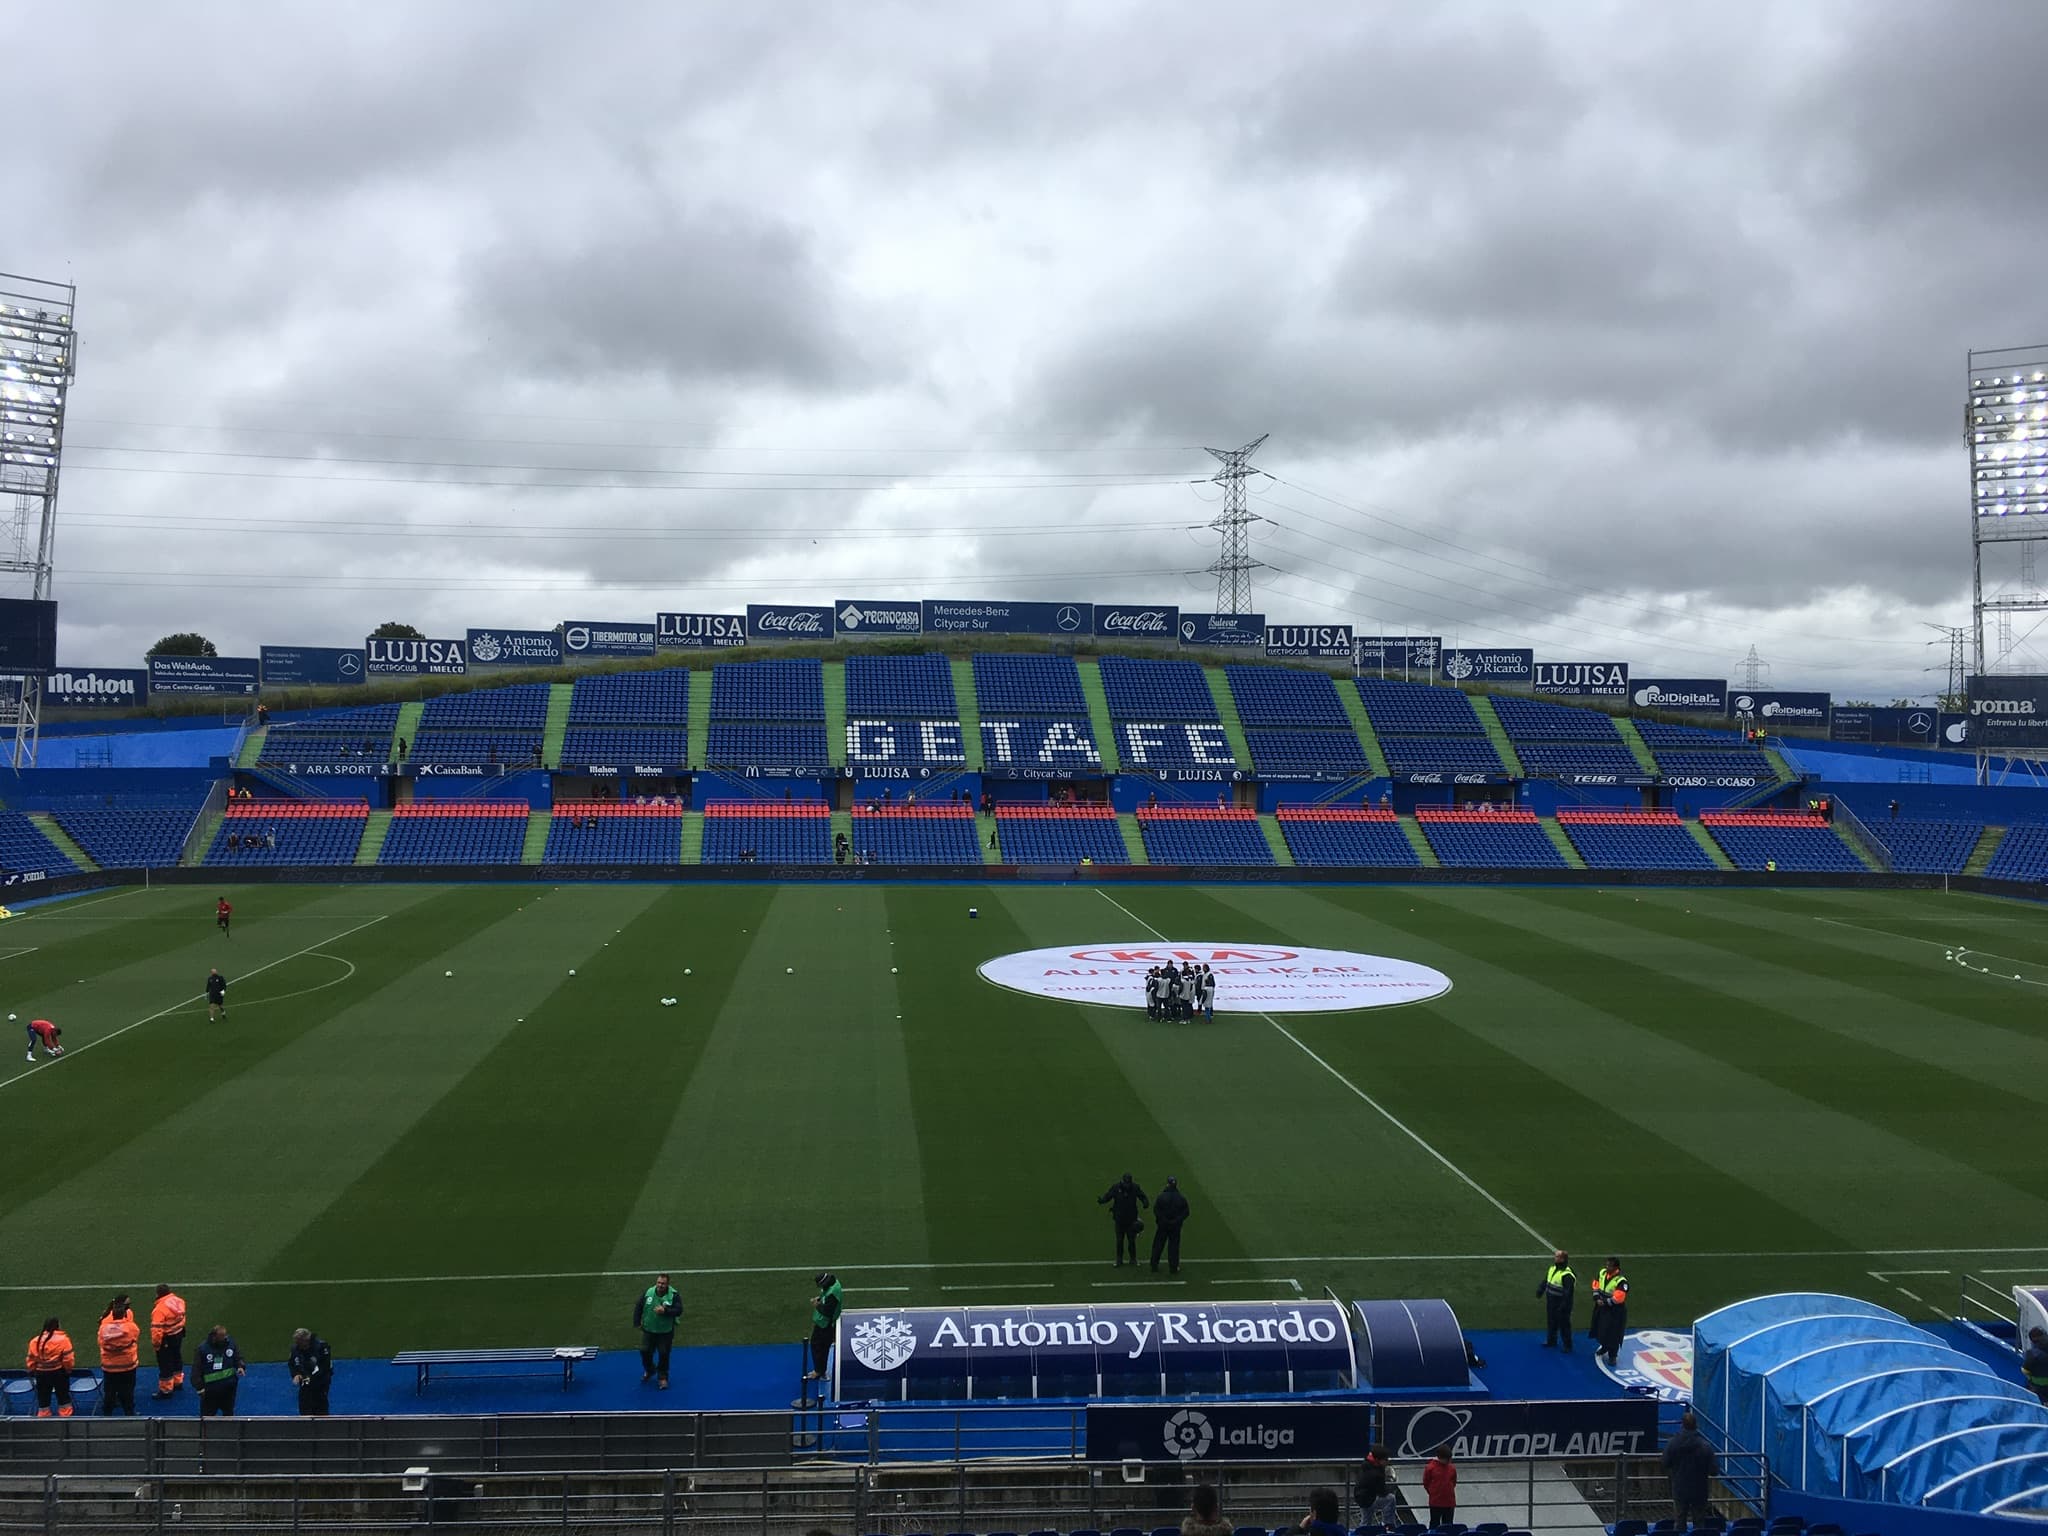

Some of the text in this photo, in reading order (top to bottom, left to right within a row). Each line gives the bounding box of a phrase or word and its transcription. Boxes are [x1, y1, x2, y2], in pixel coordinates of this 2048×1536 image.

[863, 610, 920, 625] TECNOCASA
[933, 606, 1010, 617] Mercedes-Benz
[659, 615, 744, 637] LUJISA
[758, 611, 823, 632] Coca-Cola
[933, 618, 990, 630] Citycar Sur
[1104, 611, 1168, 631] Coca-Cola
[503, 635, 552, 647] Antonio
[592, 631, 654, 643] TIBERMOTOR SUR
[1267, 628, 1350, 647] LUJISA
[368, 640, 464, 664] LUJISA
[503, 645, 559, 659] y Ricardo
[1475, 653, 1522, 664] Antonio
[154, 661, 171, 669] Das
[429, 665, 464, 673] IMELCO
[1474, 663, 1529, 676] y Ricardo
[1535, 665, 1625, 685] LUJISA
[48, 672, 136, 695] Mahou
[1591, 687, 1625, 695] IMELCO
[1986, 718, 2017, 727] Entrena
[2018, 719, 2026, 727] tu
[846, 720, 1236, 764] GETAFE
[306, 765, 373, 774] ARA SPORT
[434, 764, 484, 775] CaixaBank
[589, 766, 618, 774] Mahou
[634, 766, 663, 774] Mahou
[863, 768, 910, 778] LUJISA
[1023, 769, 1073, 779] Citycar Sur
[1178, 770, 1223, 780] LUJISA
[1573, 775, 1617, 783] TEISA
[1668, 776, 1755, 787] OCASO OCASO
[1110, 951, 1264, 961] KIA
[929, 1310, 1337, 1359] Antonio y Ricardo
[1219, 1423, 1295, 1450] LaLiga
[1451, 1431, 1645, 1458] AUTOPLANET
